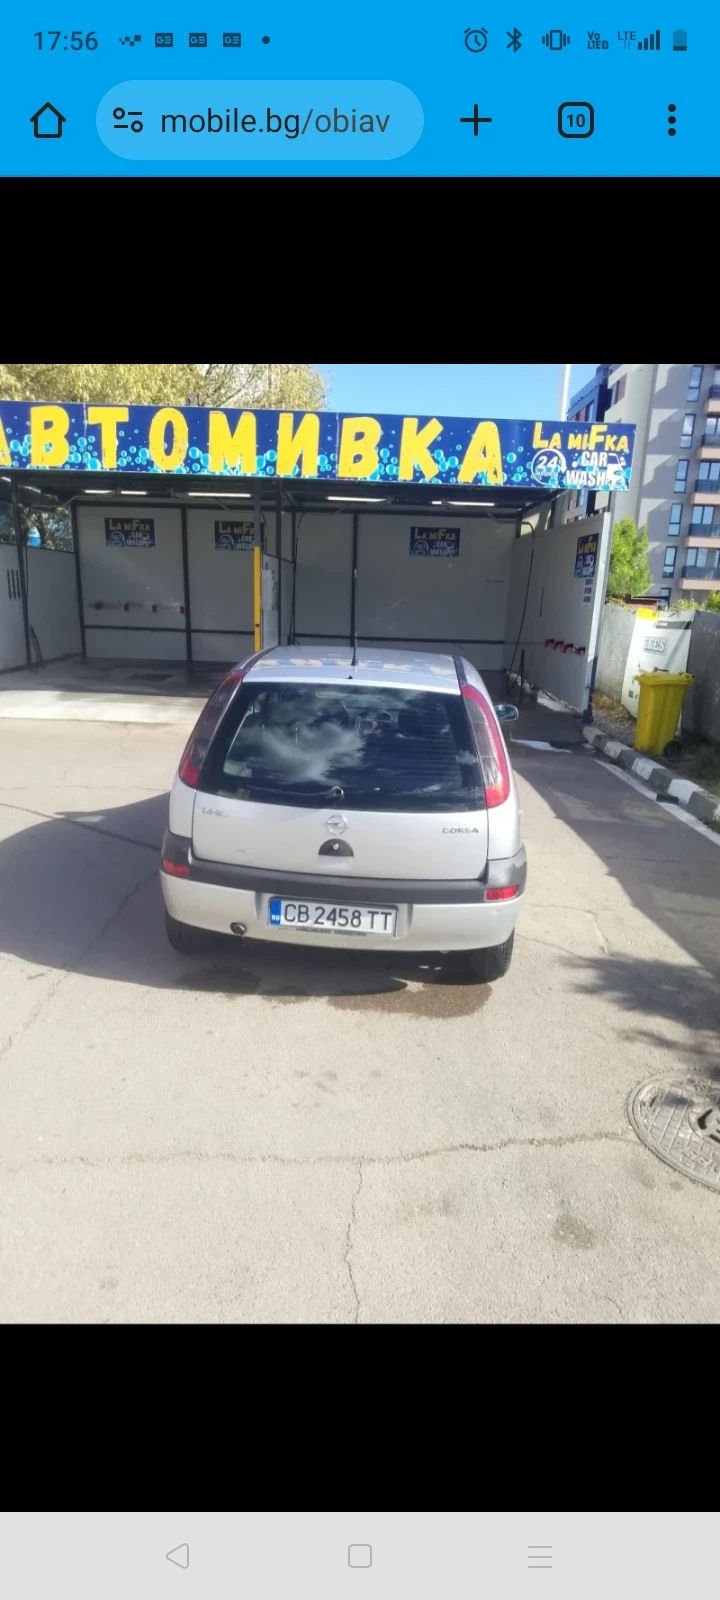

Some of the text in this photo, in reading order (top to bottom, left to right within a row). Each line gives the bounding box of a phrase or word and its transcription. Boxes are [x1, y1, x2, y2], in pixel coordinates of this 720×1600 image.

[32, 31, 99, 52] 17:56
[617, 31, 636, 40] LTE
[160, 107, 391, 139] mobile.bg/obiav
[566, 113, 586, 128] 10
[0, 404, 503, 485] ВТОМИВКА
[533, 422, 561, 449] LA
[536, 455, 559, 469] 24
[581, 451, 608, 467] CAR
[565, 470, 606, 486] WASH
[284, 904, 392, 930] CB 2458 TT
